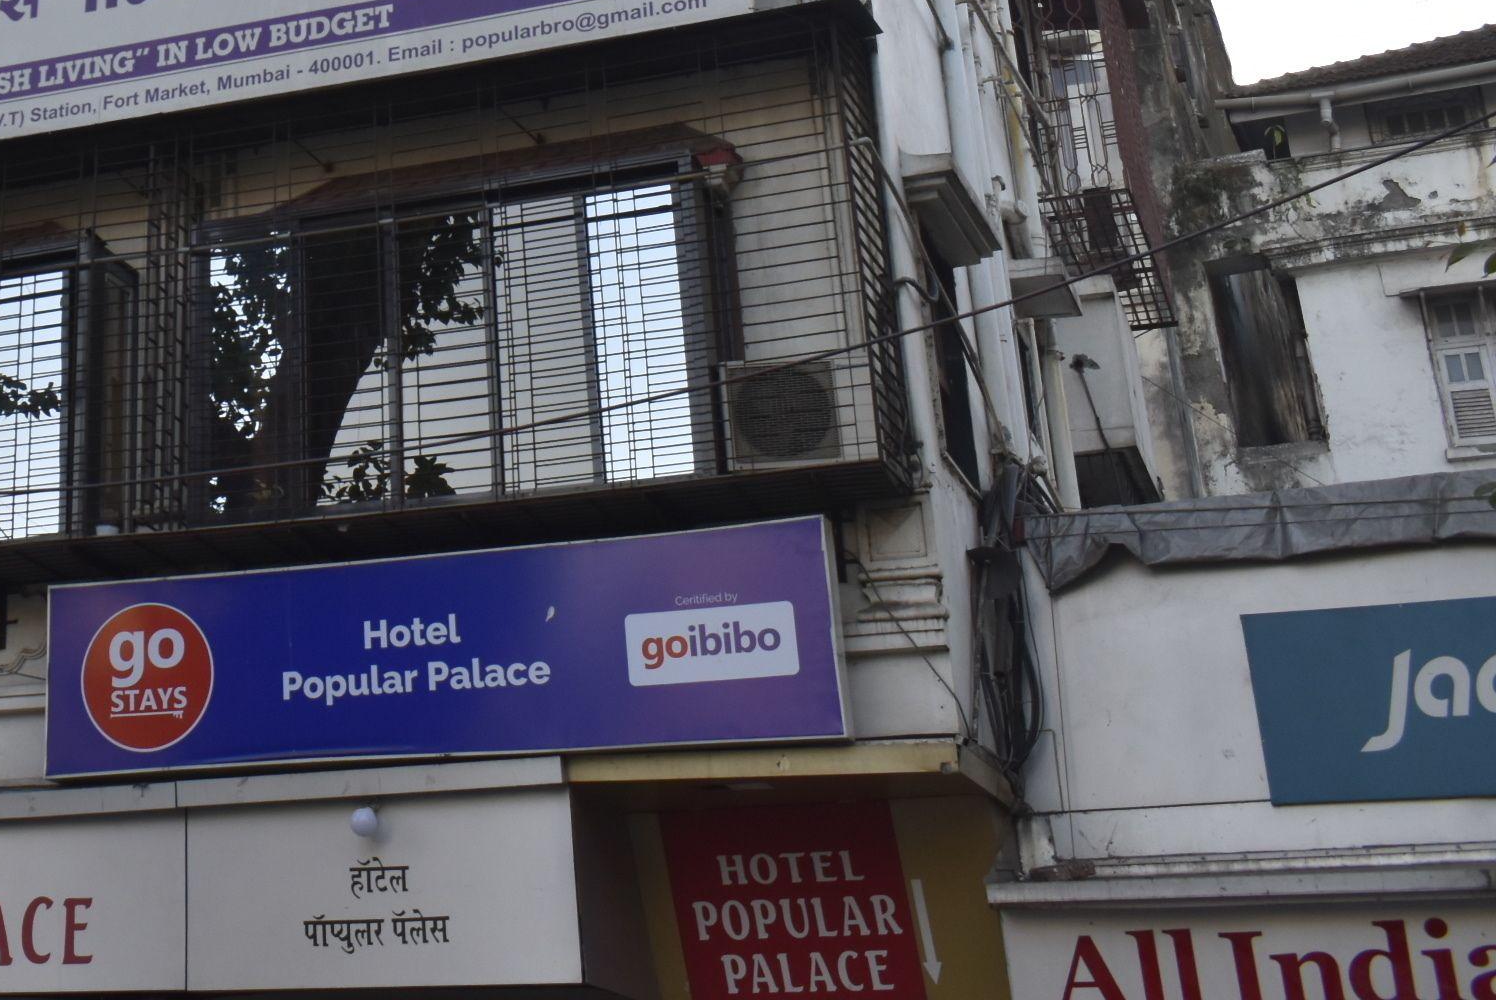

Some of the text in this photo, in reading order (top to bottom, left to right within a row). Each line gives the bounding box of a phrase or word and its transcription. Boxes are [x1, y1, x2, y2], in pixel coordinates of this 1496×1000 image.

[156, 40, 190, 68] IN
[195, 28, 262, 61] LOW
[268, 4, 394, 48] BUDGET
[30, 100, 97, 123] Station,
[103, 92, 140, 111] Fort
[145, 79, 211, 105] Market,
[217, 64, 291, 91] Mumbai
[308, 51, 382, 75] 400001.
[388, 38, 443, 62] Email
[724, 591, 738, 604] by
[363, 613, 462, 650] Hotel
[641, 621, 781, 670] goibibo
[109, 628, 185, 688] go
[110, 686, 188, 712] STAYS
[282, 657, 551, 706] Popular Palace
[349, 857, 409, 899] हॉटेल
[716, 850, 865, 885] HOTEL
[303, 914, 385, 954] पॉप्युलर
[692, 894, 904, 941] POPULAR
[720, 950, 895, 994] PALACE
[1060, 927, 1202, 1000] All
